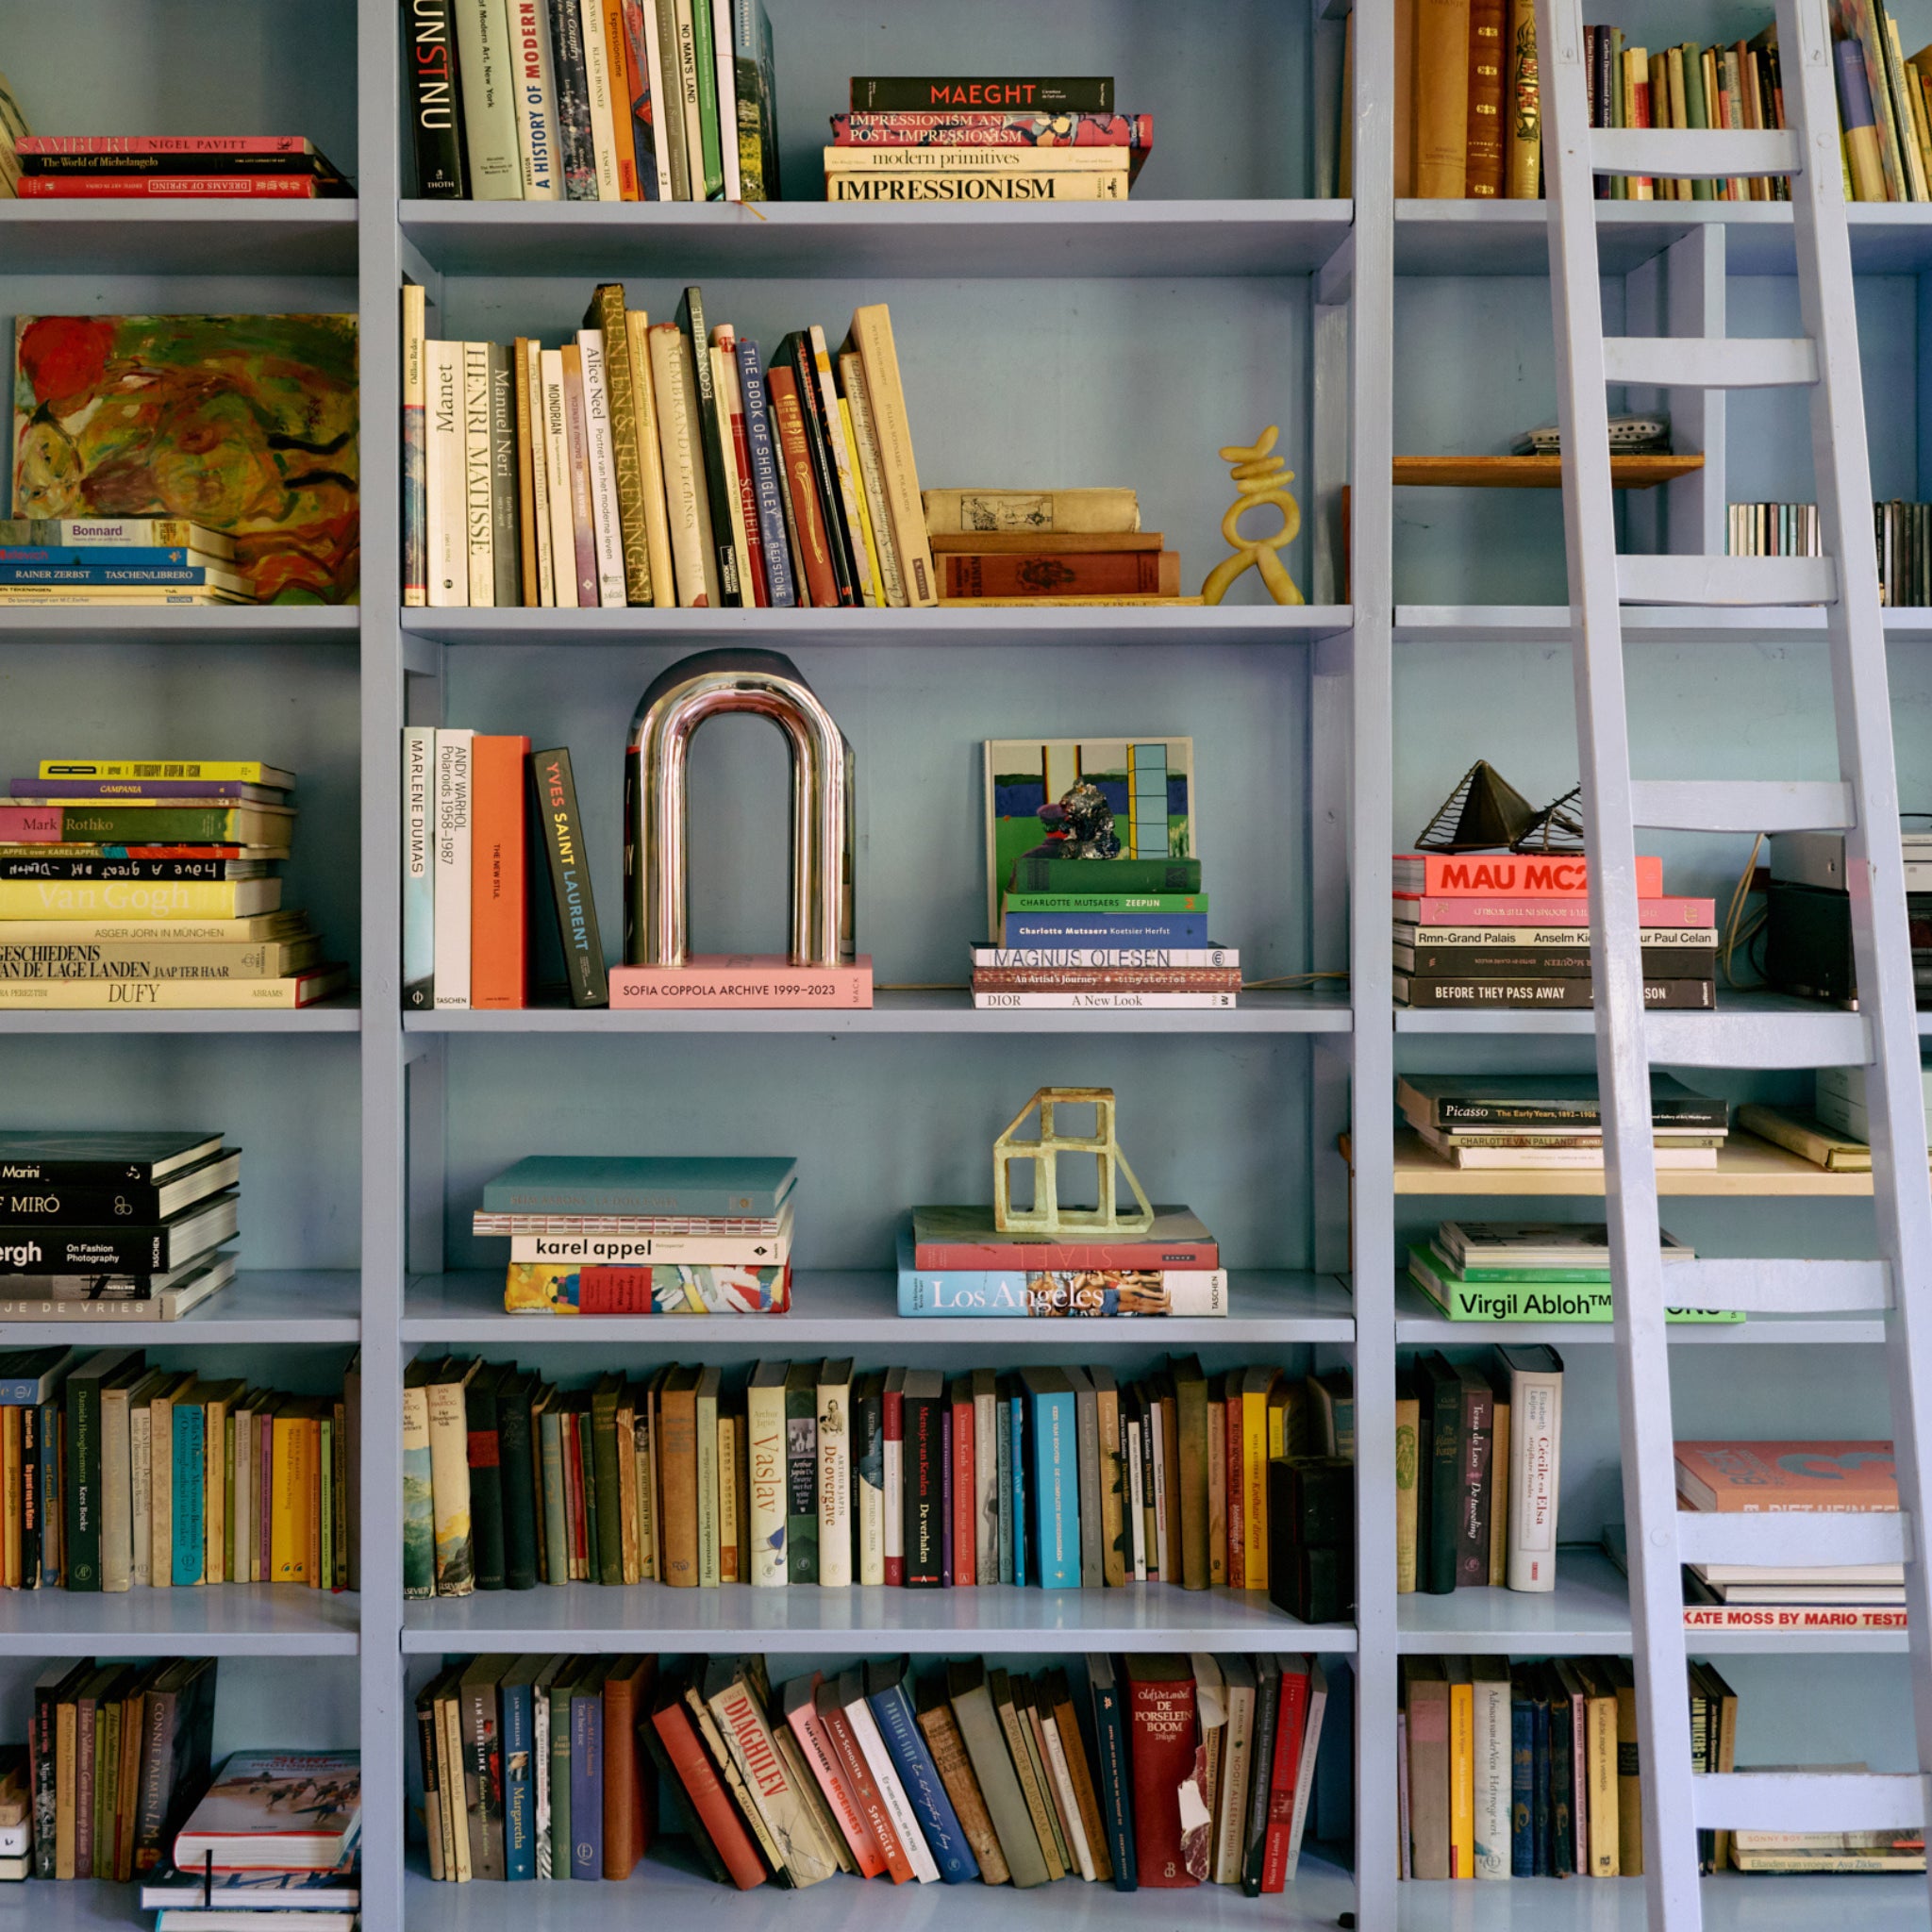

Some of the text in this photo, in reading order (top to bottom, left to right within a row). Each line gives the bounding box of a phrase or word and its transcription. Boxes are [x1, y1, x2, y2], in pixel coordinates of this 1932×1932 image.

[610, 11, 623, 78] Expressionisme
[681, 24, 696, 105] NO MAN'S LAND
[520, 3, 550, 189] A HISTORY OF MODERN
[931, 84, 1036, 104] MAEGHT
[850, 114, 1012, 126] IMPRESSIONISM AND
[149, 140, 190, 149] NIGEL
[196, 140, 247, 149] PAVITT
[873, 150, 1020, 168] modern primitives
[42, 157, 158, 171] The World of Michelangelo
[602, 149, 611, 187] TASCHEN
[152, 182, 187, 191] SPRING
[192, 182, 204, 191] OF
[207, 182, 248, 191] DREAMS
[837, 179, 1056, 200] IMPRESSIONISM
[691, 307, 713, 399] EGON SCHIELE
[436, 363, 455, 434] Manet
[587, 347, 606, 420] Alice Neel
[493, 370, 511, 478] Manuel Neri
[548, 383, 562, 435] MONDRIAN
[743, 348, 776, 517] THE BOOK OF SHRIGLEY
[466, 350, 490, 557] HENRI MATISSE
[595, 427, 612, 560] Portret van het moderne leven
[738, 477, 760, 547] SCHIELE
[73, 525, 123, 536] Bonnard
[768, 542, 788, 599] REDSTONE
[100, 785, 142, 794] CAMPANIA
[454, 746, 467, 832] ANDY WARHOL
[546, 761, 565, 807] YVES
[411, 740, 424, 874] MARLENE DUMAS
[24, 817, 114, 831] Mark Rothko
[554, 812, 575, 865] SAINT
[39, 882, 190, 918] Van Gogh
[563, 869, 590, 951] LAURENT
[95, 927, 225, 938] ASGER JORN IN MÜNCHEN
[1019, 926, 1171, 936] Charlotte Mutsaers Koetsier Herfst
[994, 949, 1170, 966] MAGNUS OLESEN
[107, 983, 161, 1003] DUFY
[252, 989, 284, 998] ABRAMS
[435, 996, 468, 1005] TASCHEN
[624, 985, 658, 996] SOFIA
[661, 985, 717, 996] COPPOLA
[719, 985, 770, 996] ARCHIVE
[852, 976, 860, 1003] MACK
[988, 994, 1143, 1007] DIOR A New Look
[1435, 987, 1565, 999] BEFORE THEY PASS AWAY
[1459, 1137, 1579, 1146] CHARLOTTE VAN PALLANDT
[3, 1165, 40, 1178] Marini
[11, 1193, 60, 1213] MIRÓ
[66, 1243, 114, 1253] On Fashion
[66, 1253, 120, 1264] Photography
[153, 1236, 161, 1269] TASCHEN
[536, 1239, 652, 1260] karel appel
[1013, 1245, 1114, 1268] STAEL
[932, 1279, 1105, 1316] Los Angeles
[76, 1391, 89, 1421] Daniela
[1538, 1391, 1548, 1430] Elisabeth
[1472, 1404, 1484, 1468] Tessa de Loo
[753, 1433, 782, 1513] Vaslav
[1537, 1437, 1550, 1480] Cécile
[78, 1486, 90, 1505] Kees
[820, 1445, 839, 1526] De overgave
[837, 1454, 847, 1517] ARTHUR JAPIN
[919, 1406, 931, 1563] Mensje van Keulen De verhalen
[79, 1507, 90, 1532] Boeke
[1468, 1482, 1482, 1540] De tweeling
[1536, 1495, 1549, 1525] Elsa
[1683, 1612, 1724, 1624] KATE
[1727, 1612, 1774, 1624] MOSS
[1779, 1613, 1801, 1625] BY
[1804, 1613, 1858, 1625] MARIO
[577, 1703, 587, 1716] Tot
[1135, 1711, 1192, 1722] PORSELEIN
[1157, 1700, 1173, 1711] DE
[150, 1702, 165, 1754] CONNIE
[475, 1697, 488, 1772] JAN SIEBELINK
[577, 1717, 587, 1733] hier
[1146, 1722, 1184, 1733] BOOM
[723, 1695, 790, 1799] DIAGHILEV
[833, 1720, 862, 1779] JAAP SCHOLTEN
[1234, 1755, 1242, 1780] NOOIT
[146, 1758, 160, 1809] PALMEN
[511, 1787, 527, 1850] Margaretha
[828, 1776, 863, 1837] BROEINEST
[867, 1804, 896, 1859] SPENGLER
